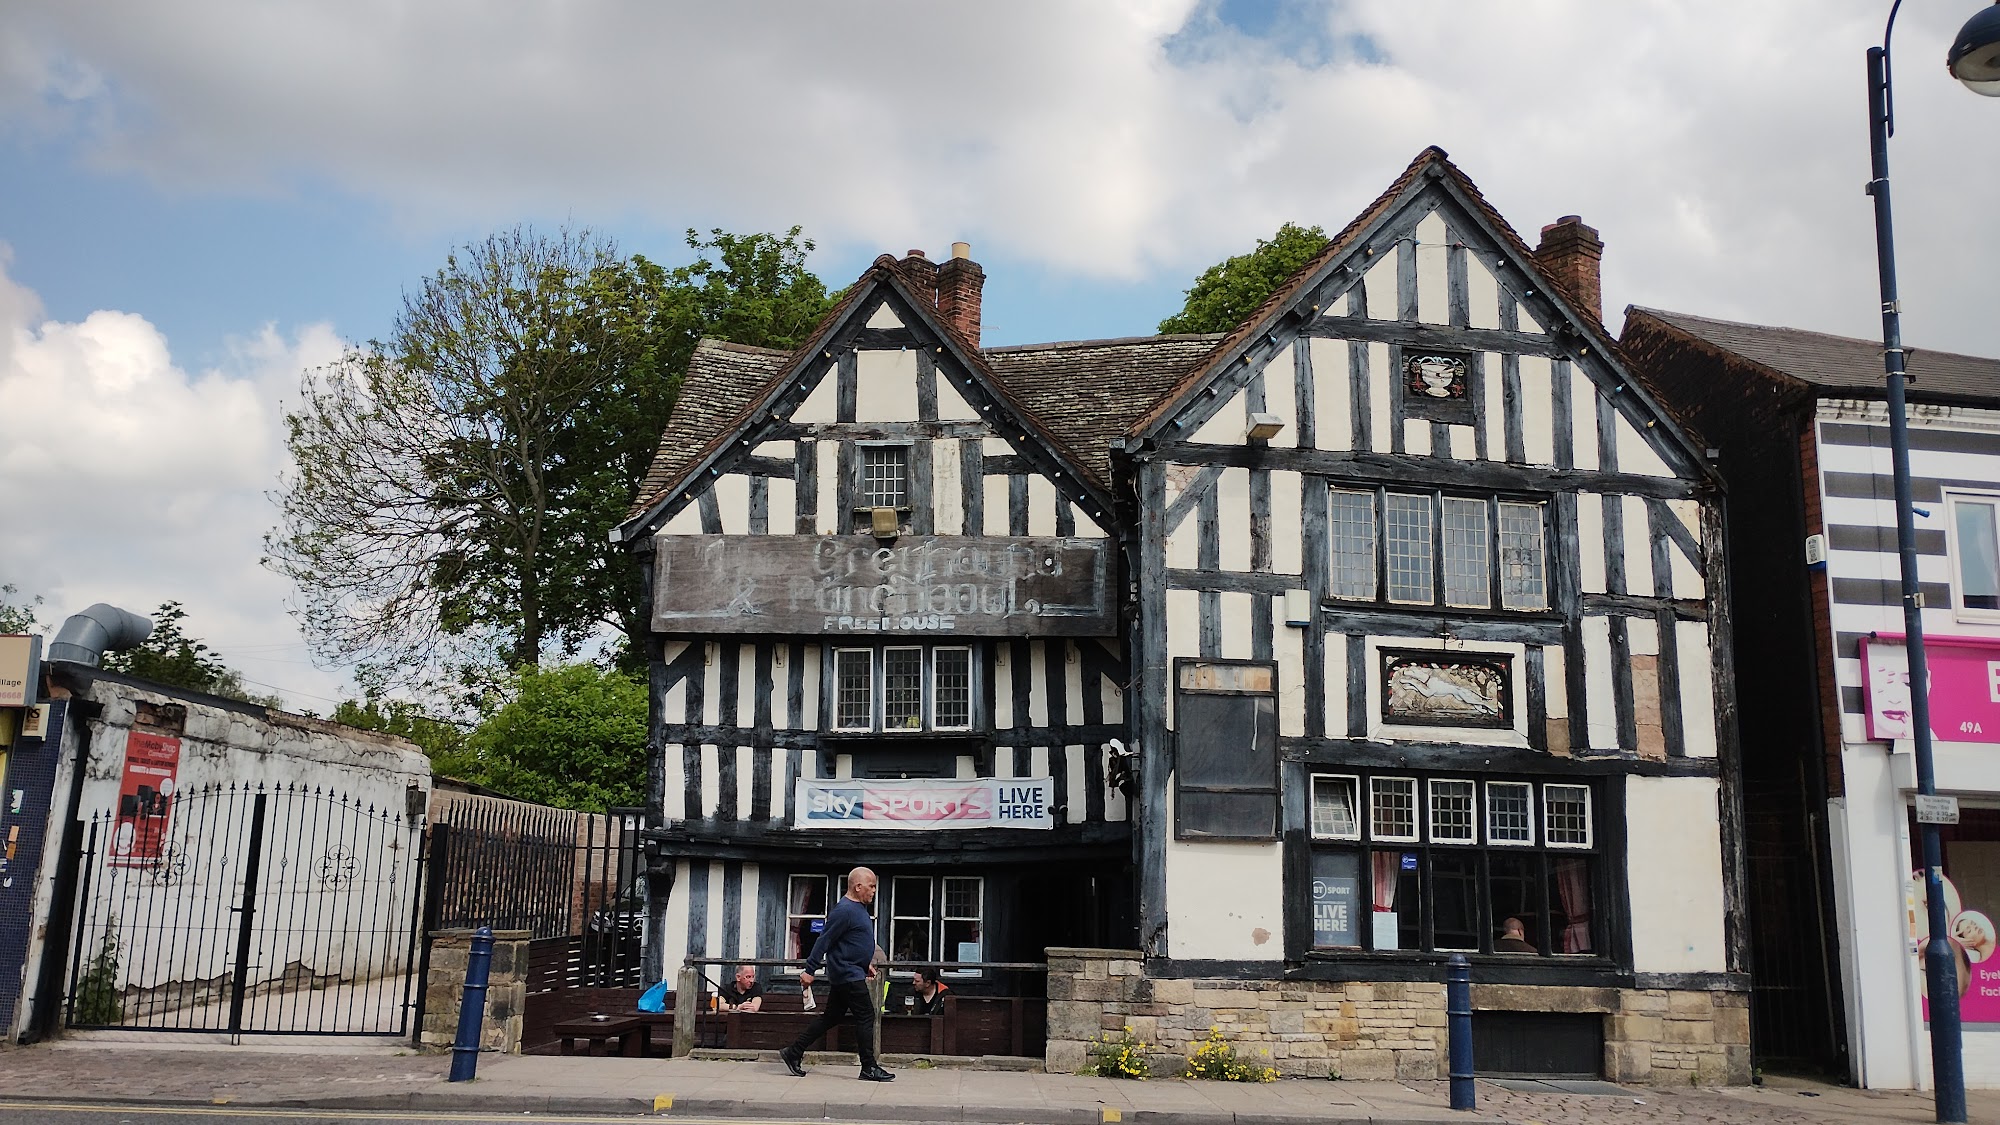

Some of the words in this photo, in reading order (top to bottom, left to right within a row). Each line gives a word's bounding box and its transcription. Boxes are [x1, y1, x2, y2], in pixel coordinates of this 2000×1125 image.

[1959, 721, 1983, 734] 49A
[999, 787, 1044, 804] LIVE
[869, 792, 987, 816] SPORTS
[998, 805, 1044, 819] HERE
[1313, 886, 1324, 894] BT
[1327, 886, 1351, 895] SPORT
[1313, 904, 1348, 919] LIVE
[1313, 918, 1348, 932] HERE
